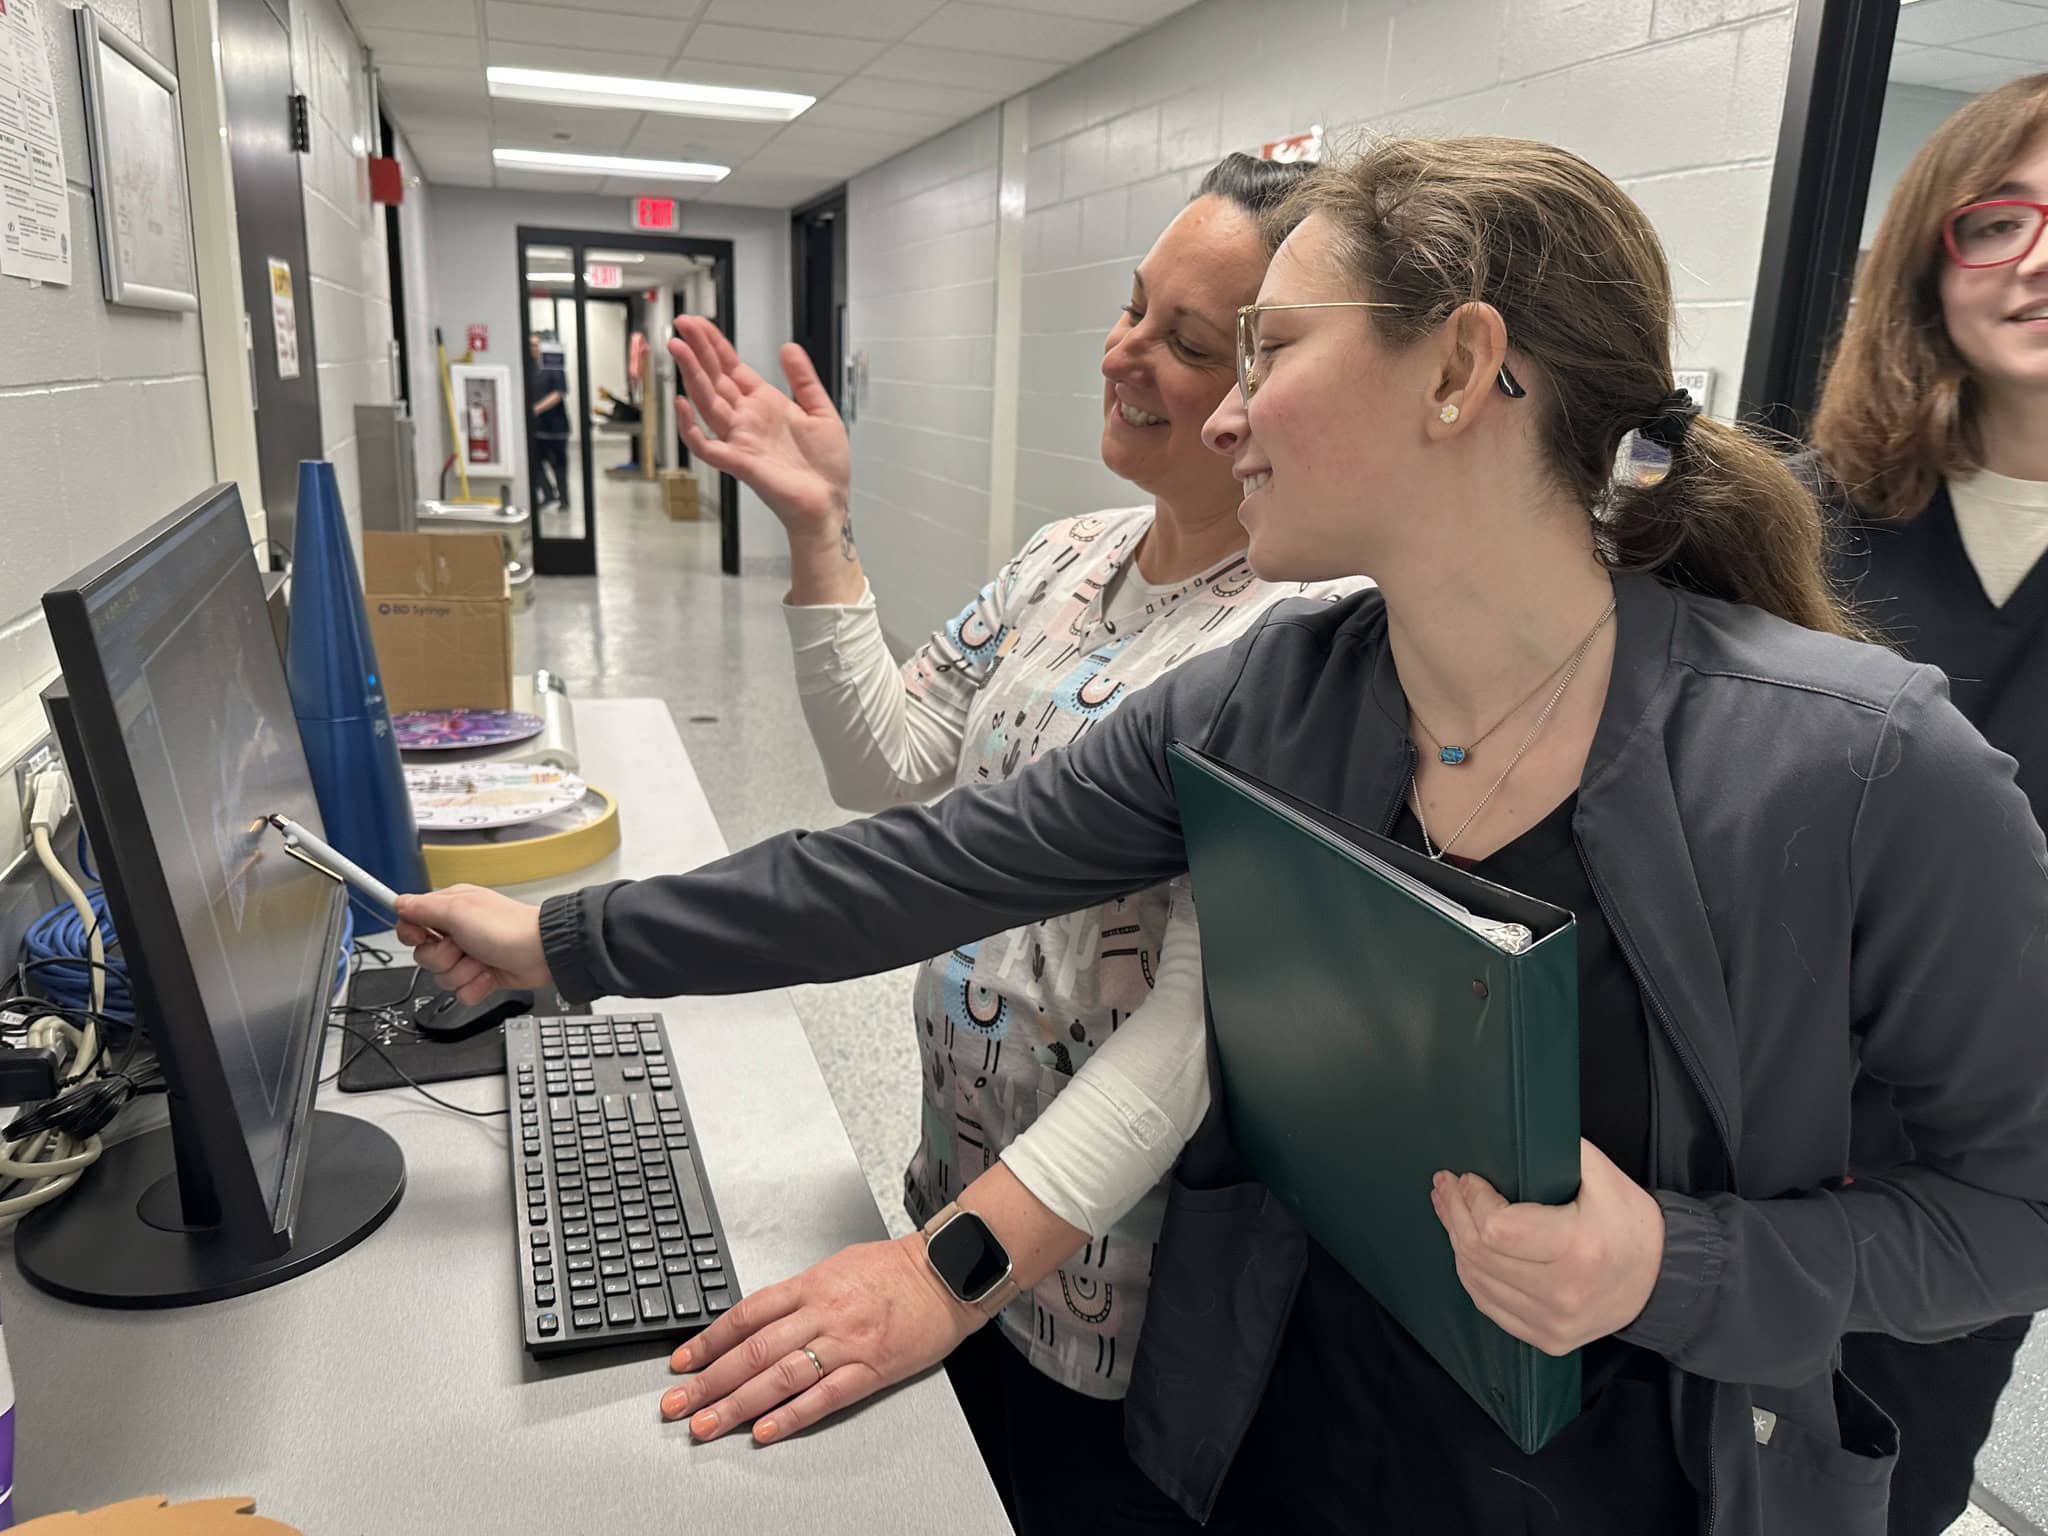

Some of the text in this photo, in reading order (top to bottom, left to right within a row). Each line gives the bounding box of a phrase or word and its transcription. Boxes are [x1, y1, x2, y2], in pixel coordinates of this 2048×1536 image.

[639, 198, 674, 227] EXIT
[392, 604, 451, 618] BD Syringe
